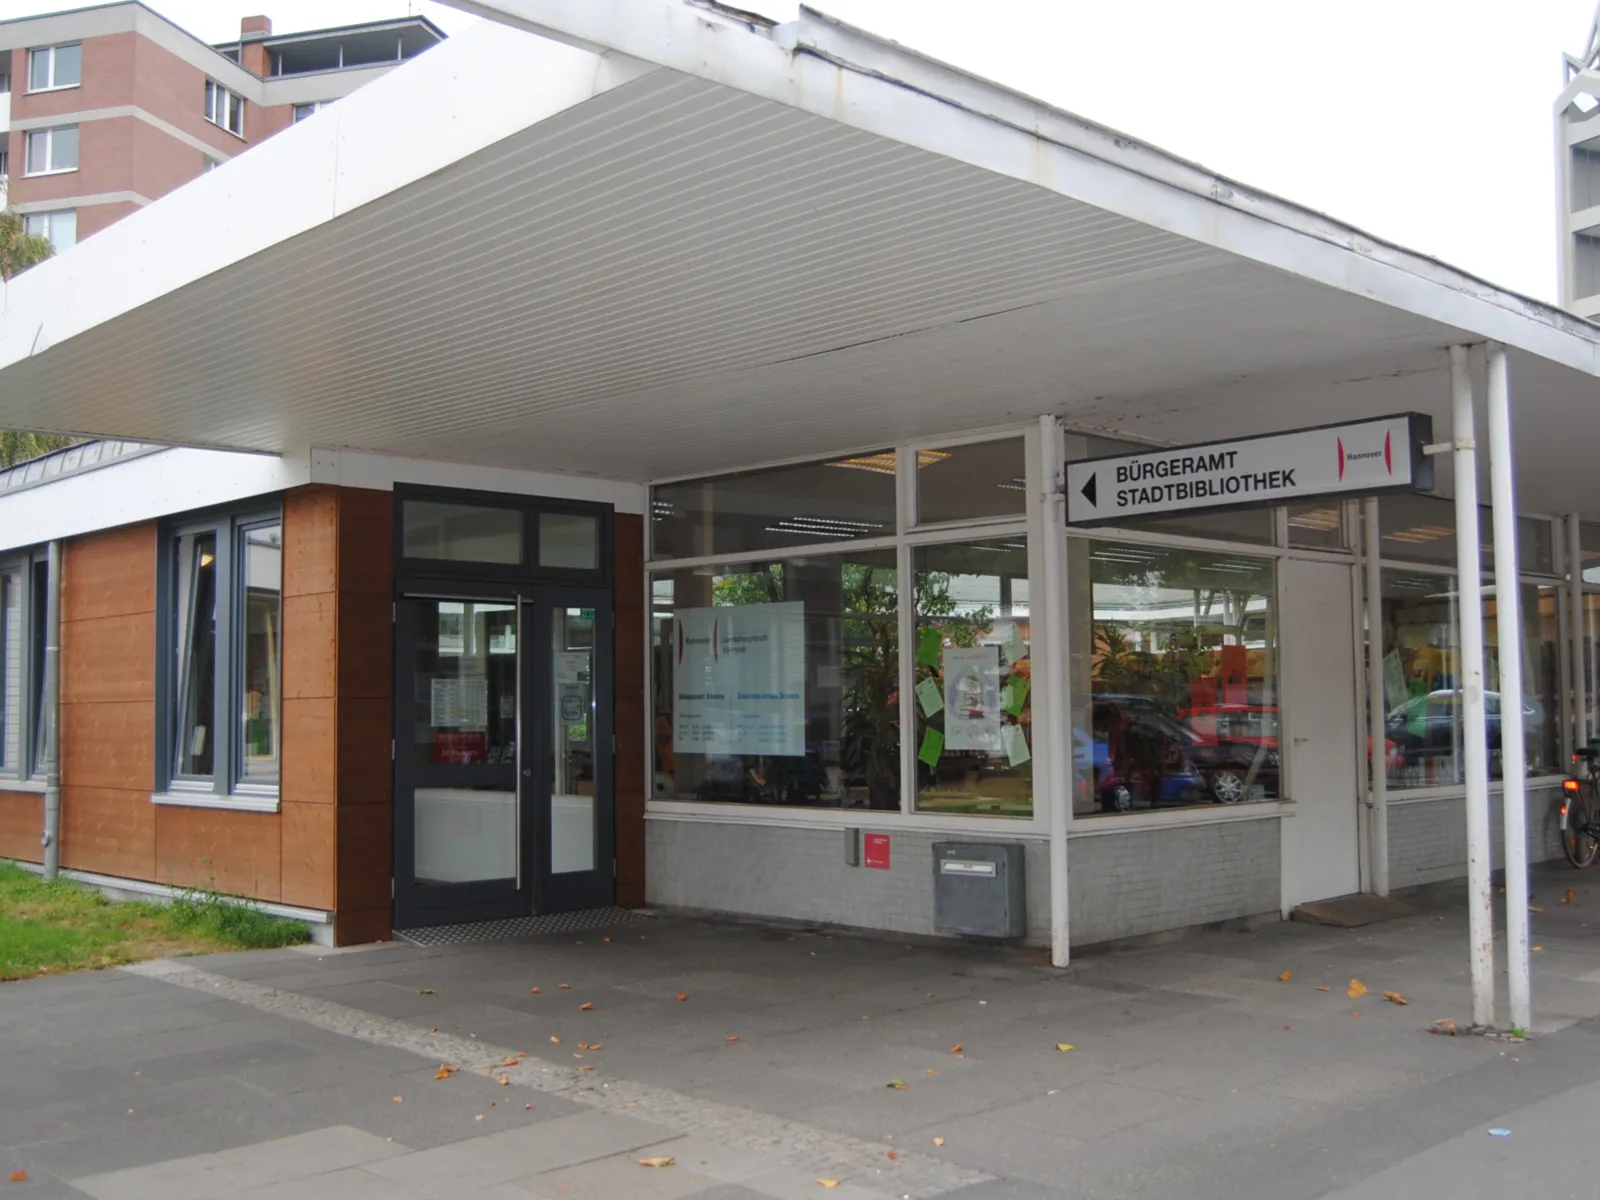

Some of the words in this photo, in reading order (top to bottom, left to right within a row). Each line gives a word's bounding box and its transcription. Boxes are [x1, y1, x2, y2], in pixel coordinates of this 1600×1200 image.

[1116, 451, 1237, 483] BÜRGERAMT
[1346, 450, 1382, 461] Hannover
[1116, 469, 1297, 507] STADTBIBLIOTHEK
